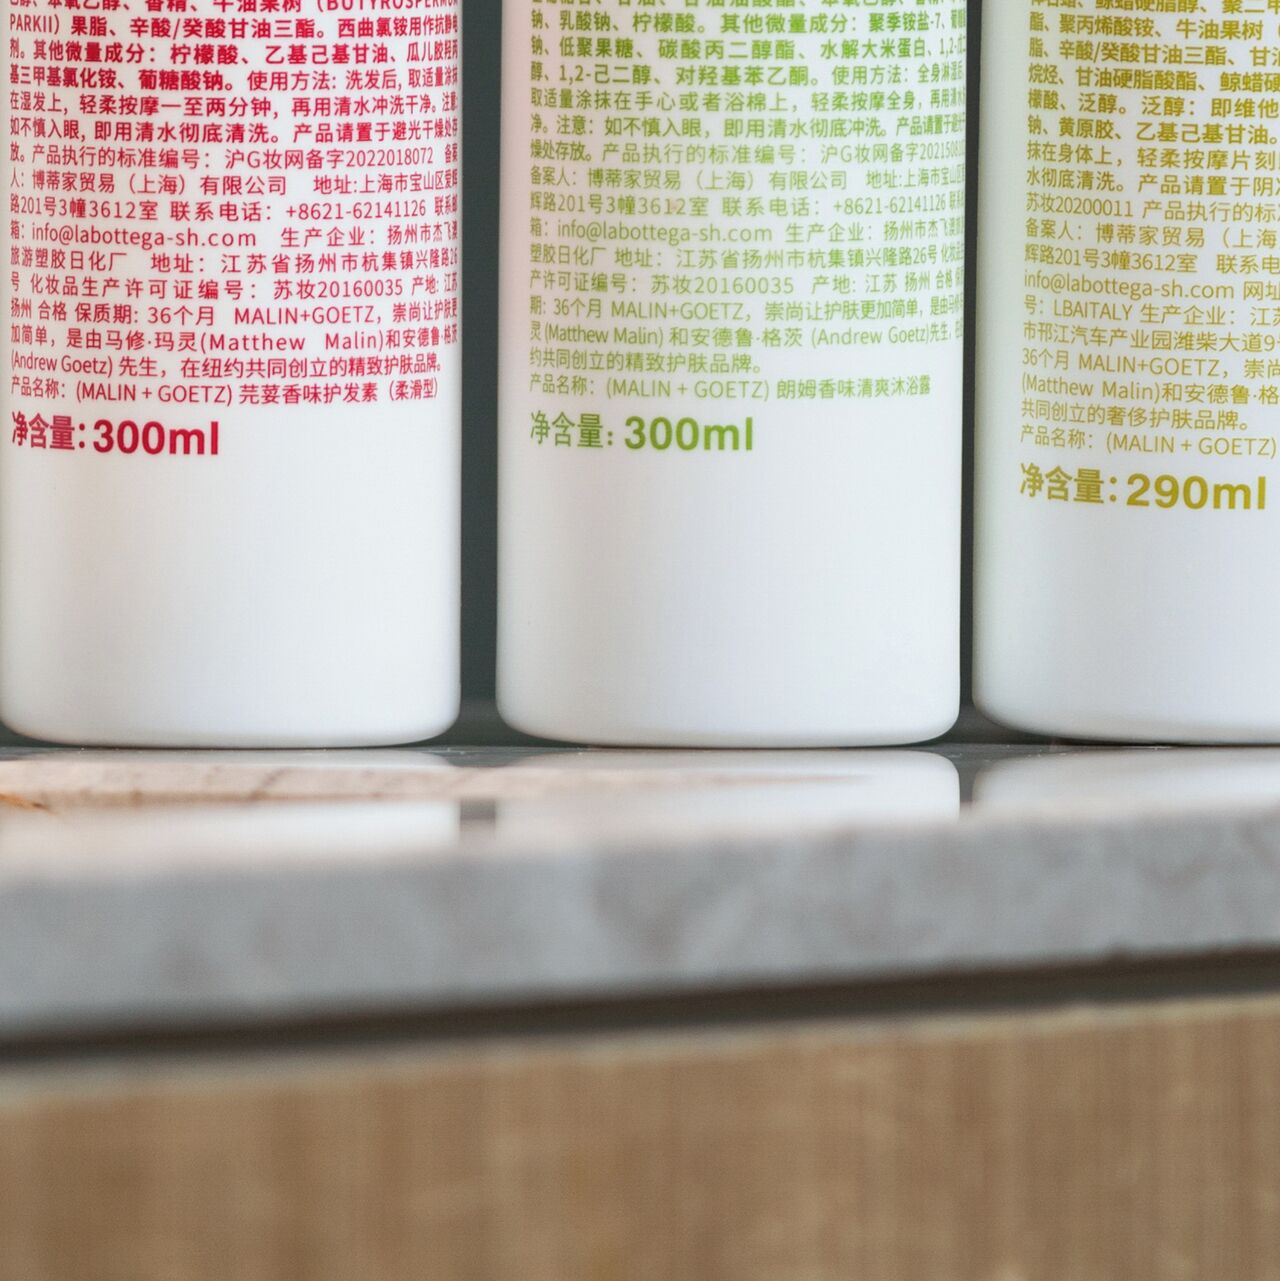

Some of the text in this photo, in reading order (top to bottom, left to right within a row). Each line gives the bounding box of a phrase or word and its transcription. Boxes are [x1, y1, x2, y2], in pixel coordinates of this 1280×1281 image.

[285, 197, 427, 222] +8621-62141126
[833, 193, 946, 216] +8621-62141126
[1025, 189, 1134, 219] 苏妆20200011
[31, 220, 257, 250] info@labottega-sh.com
[557, 217, 773, 246] info@labottega-sh.com
[870, 272, 897, 294] 江苏
[904, 271, 931, 292] 扬州
[1023, 268, 1235, 301] info@labottega-sh.com
[10, 294, 33, 321] 扬州
[37, 298, 68, 323] 合格
[147, 303, 215, 328] 36个月
[553, 296, 603, 321] 36个月
[1052, 297, 1134, 323] LBAITALY
[544, 321, 610, 346] (Matthew
[612, 325, 664, 350] Malin)
[811, 327, 882, 348] (Andrew
[10, 348, 58, 373] (Andrew
[60, 353, 114, 379] Goetz)
[1022, 346, 1070, 373] 36个月
[75, 379, 137, 405] (MALIN
[141, 385, 153, 400] +
[156, 382, 233, 408] GOETZ)
[605, 376, 672, 401] (MALIN
[676, 382, 689, 396] +
[693, 379, 769, 401] GOETZ)
[1021, 371, 1095, 398] (Matthew
[1105, 431, 1175, 456] (MALIN
[1180, 438, 1193, 453] +
[1197, 436, 1277, 460] GOETZ)
